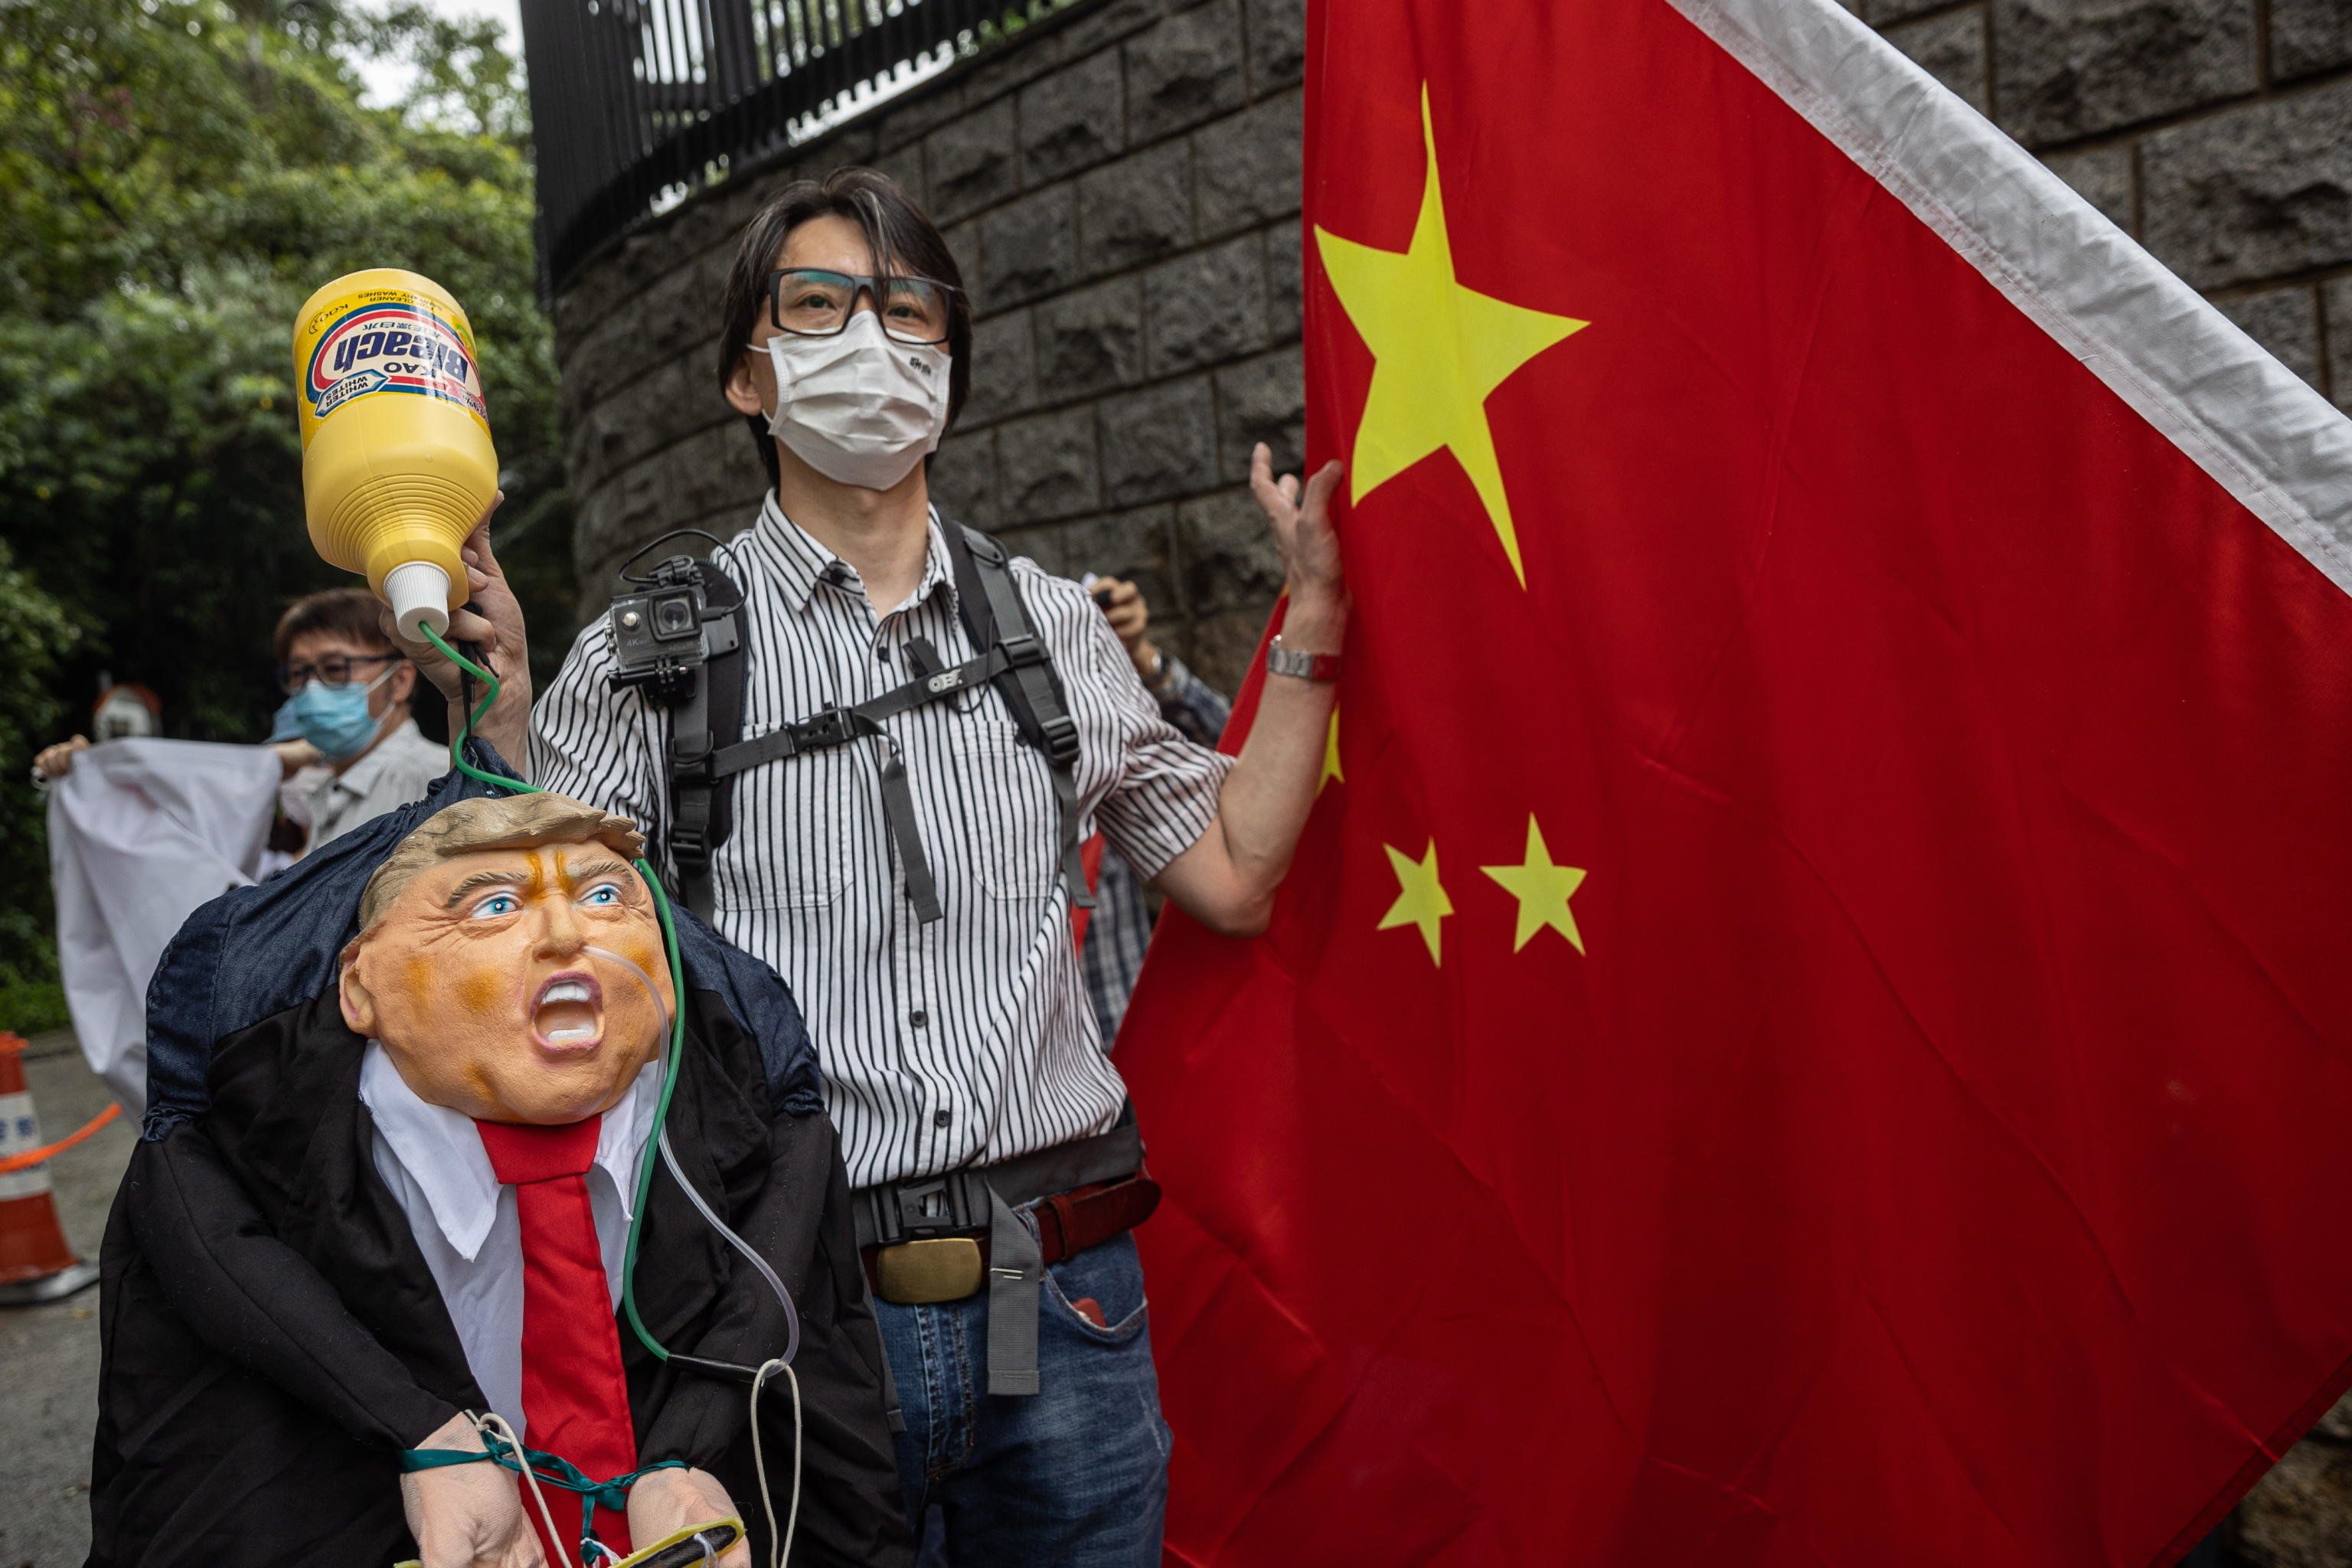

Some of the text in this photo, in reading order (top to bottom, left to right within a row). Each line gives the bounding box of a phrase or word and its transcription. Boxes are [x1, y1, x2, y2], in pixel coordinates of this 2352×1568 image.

[333, 331, 469, 384] Bleach
[384, 361, 436, 379] KAO
[325, 376, 368, 401] WHITES
[325, 382, 369, 407] WHITER
